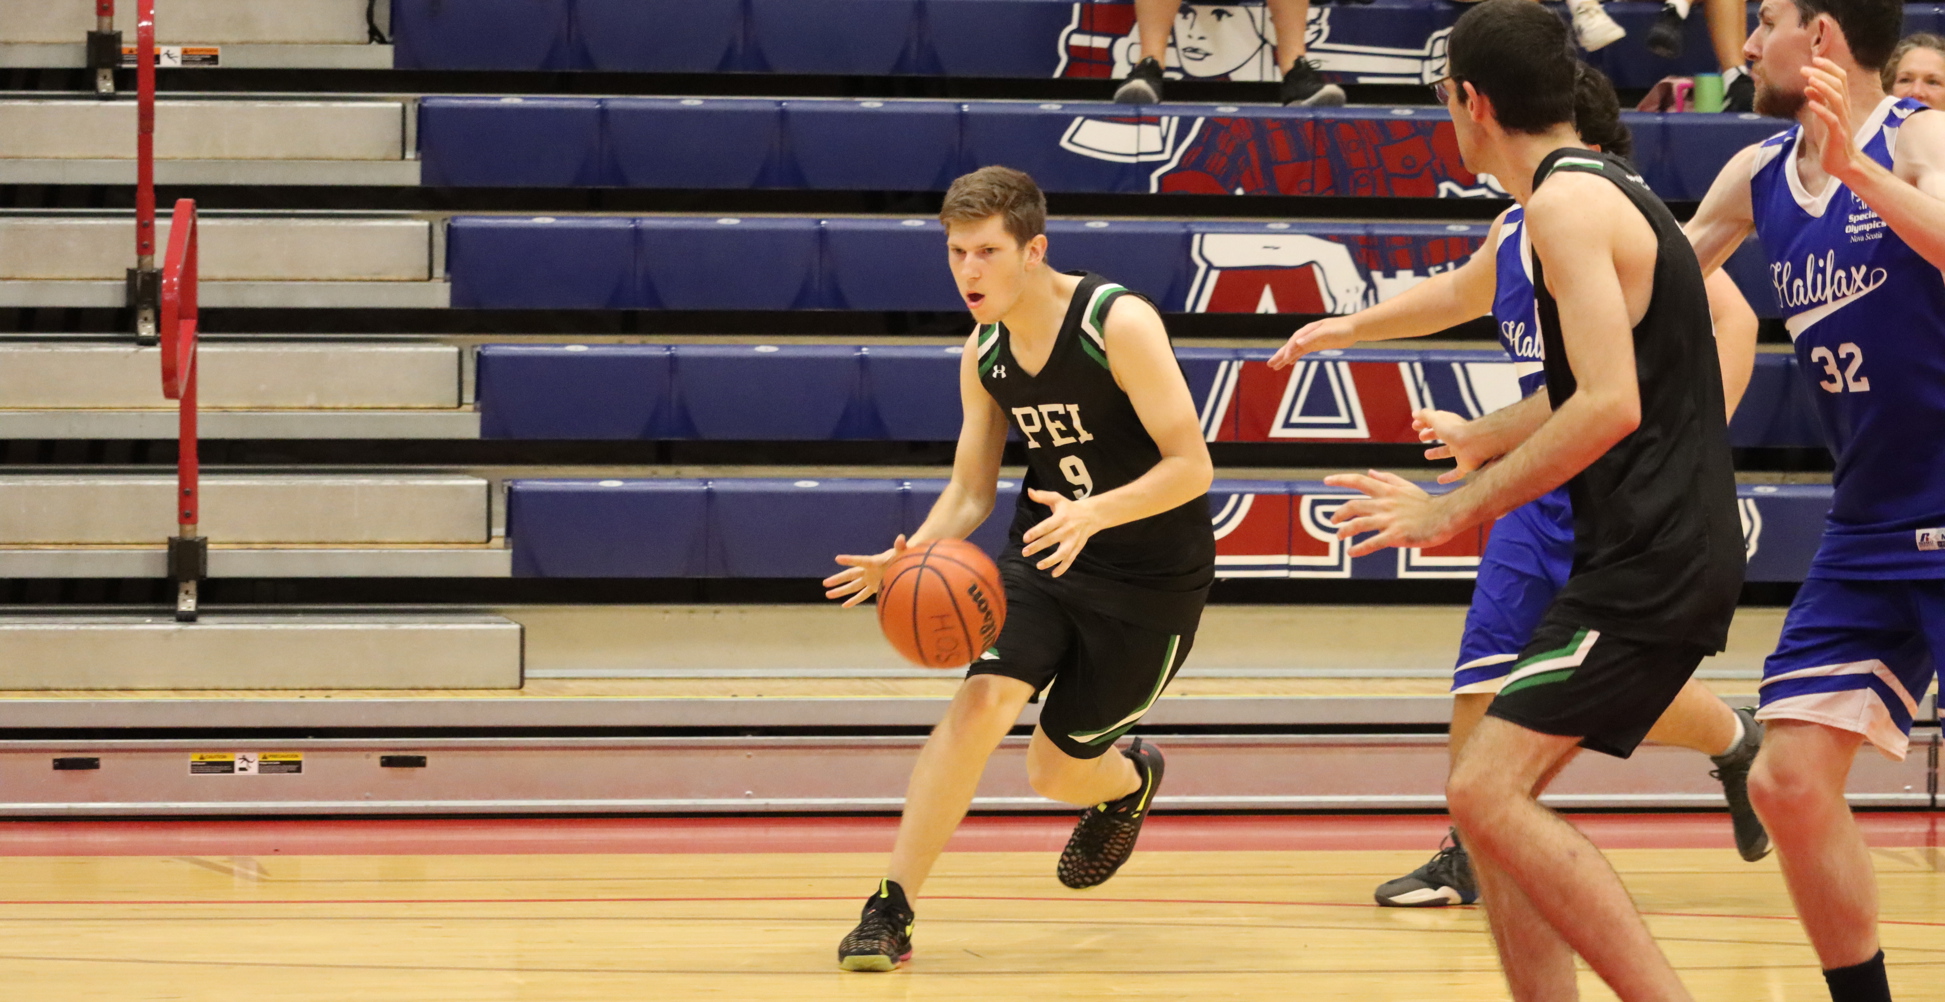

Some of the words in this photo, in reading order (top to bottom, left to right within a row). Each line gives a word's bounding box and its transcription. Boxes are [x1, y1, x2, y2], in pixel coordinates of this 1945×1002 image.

[1845, 220, 1887, 234] Olympics
[1848, 210, 1879, 224] Specia
[1850, 235, 1865, 243] Nova
[1865, 231, 1883, 241] Scotia
[1770, 249, 1887, 309] Halifax
[1811, 342, 1870, 393] 32
[1011, 403, 1094, 449] PEI
[1059, 455, 1093, 501] 9
